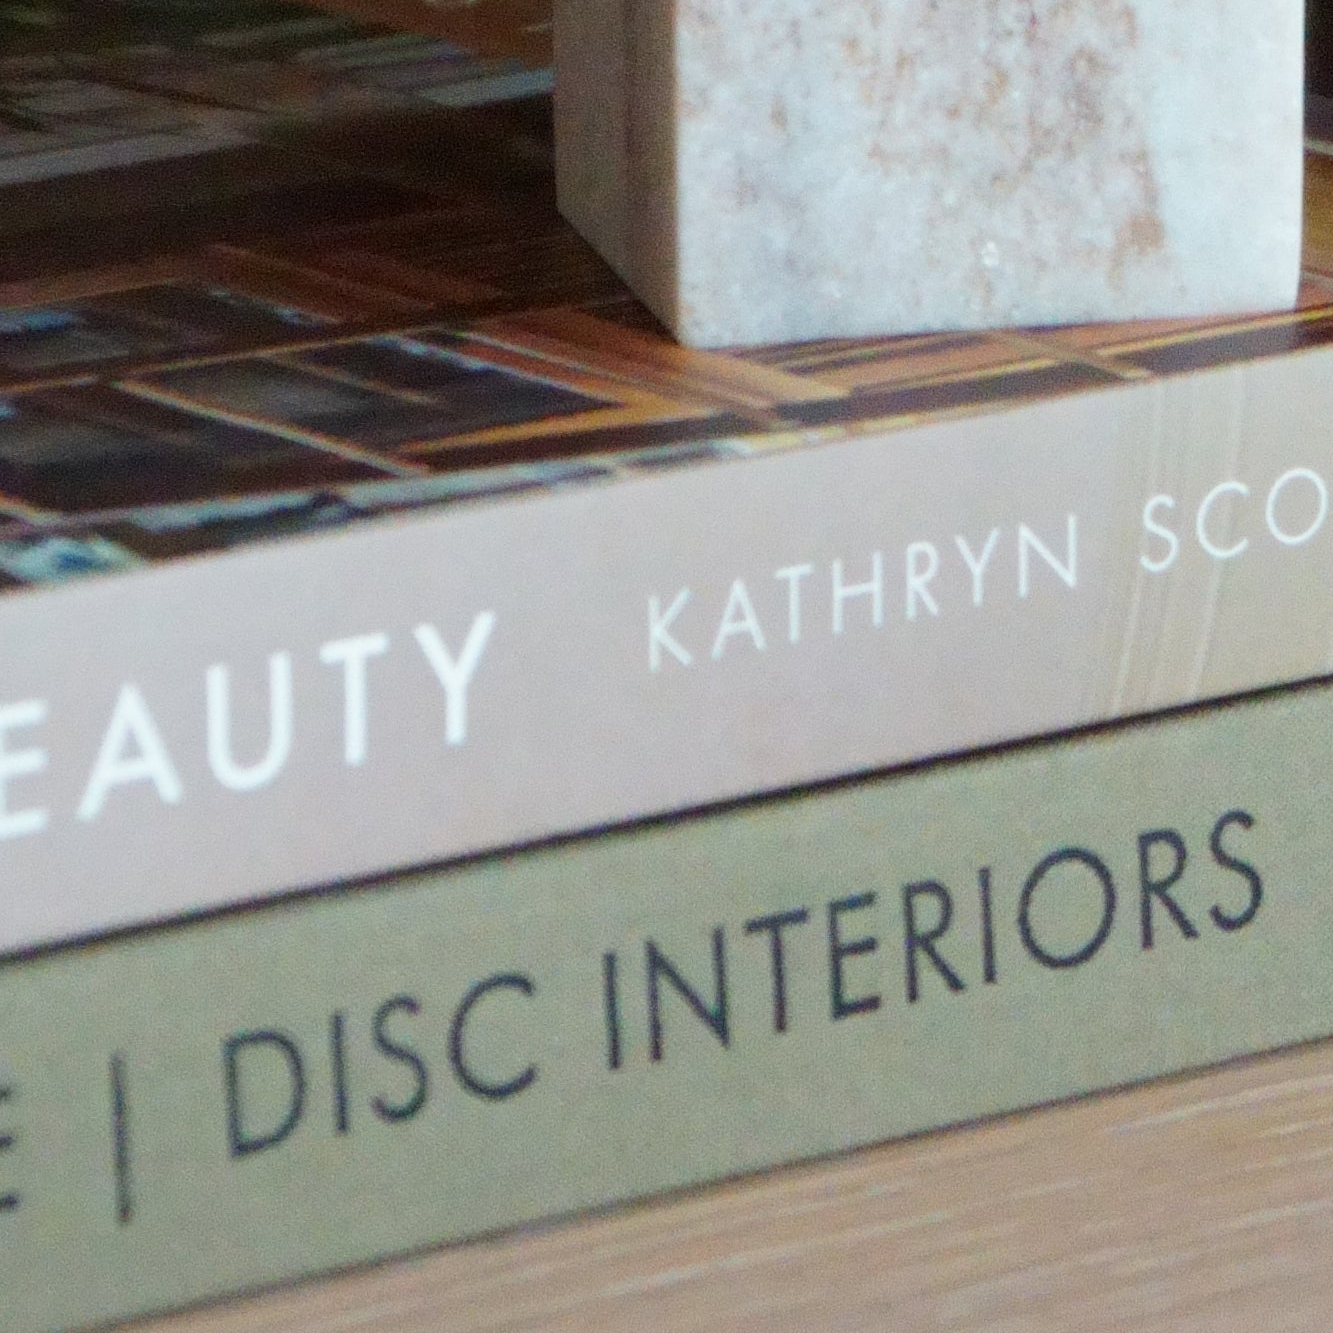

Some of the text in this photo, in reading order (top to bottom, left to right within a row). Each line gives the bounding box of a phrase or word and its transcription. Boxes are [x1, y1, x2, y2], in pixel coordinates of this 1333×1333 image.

[648, 514, 1077, 669] KATHRYN
[224, 973, 536, 1159] DISC
[600, 808, 1266, 1070] INTERIORS
